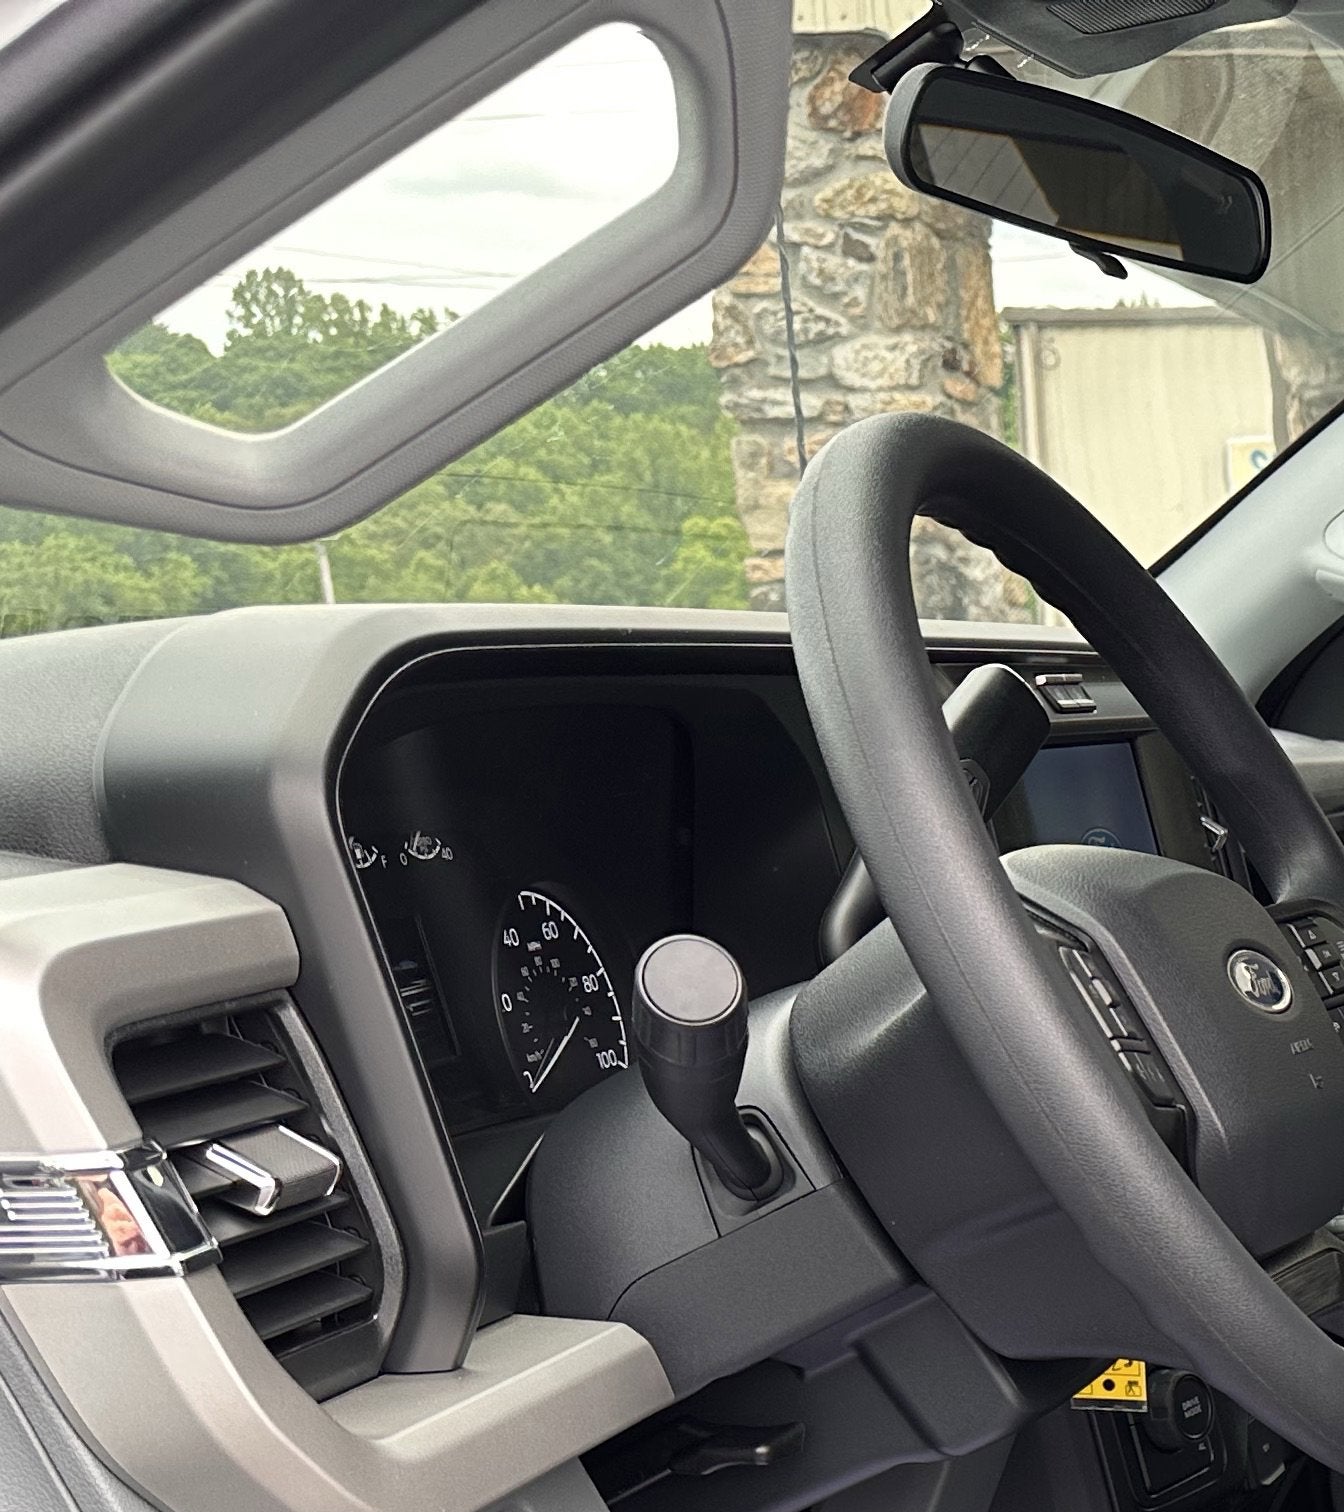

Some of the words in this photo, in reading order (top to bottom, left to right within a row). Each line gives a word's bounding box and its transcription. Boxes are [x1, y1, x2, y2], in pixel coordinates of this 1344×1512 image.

[503, 928, 520, 947] 40
[541, 921, 559, 940] 60
[581, 973, 599, 993] 80
[595, 1049, 618, 1070] 100
